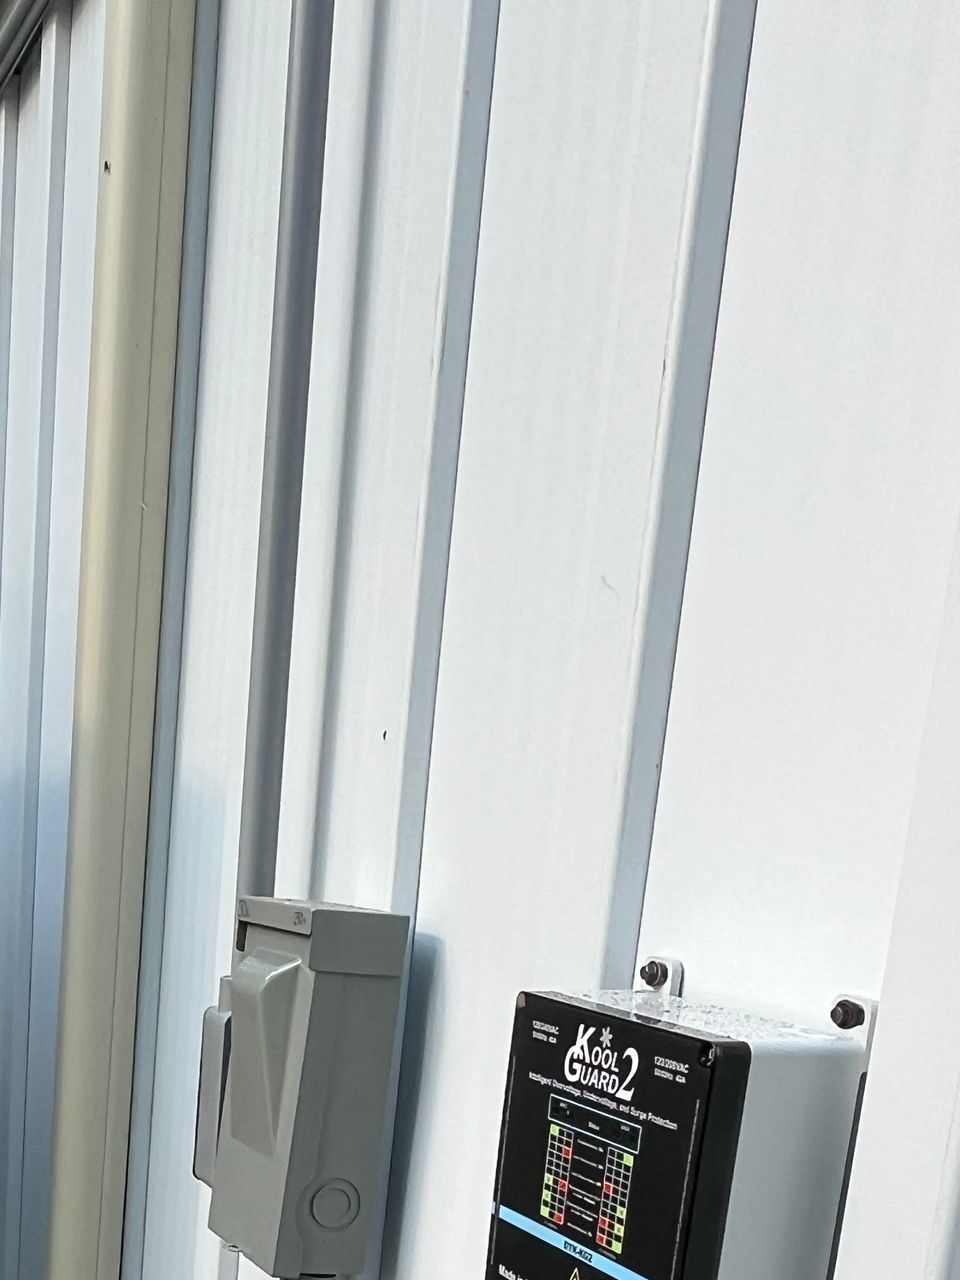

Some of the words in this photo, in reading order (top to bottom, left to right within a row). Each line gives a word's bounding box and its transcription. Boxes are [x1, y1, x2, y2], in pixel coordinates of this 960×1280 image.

[564, 1044, 619, 1095] GUARD
[614, 1048, 639, 1101] 2
[573, 1023, 619, 1072] KOOL
